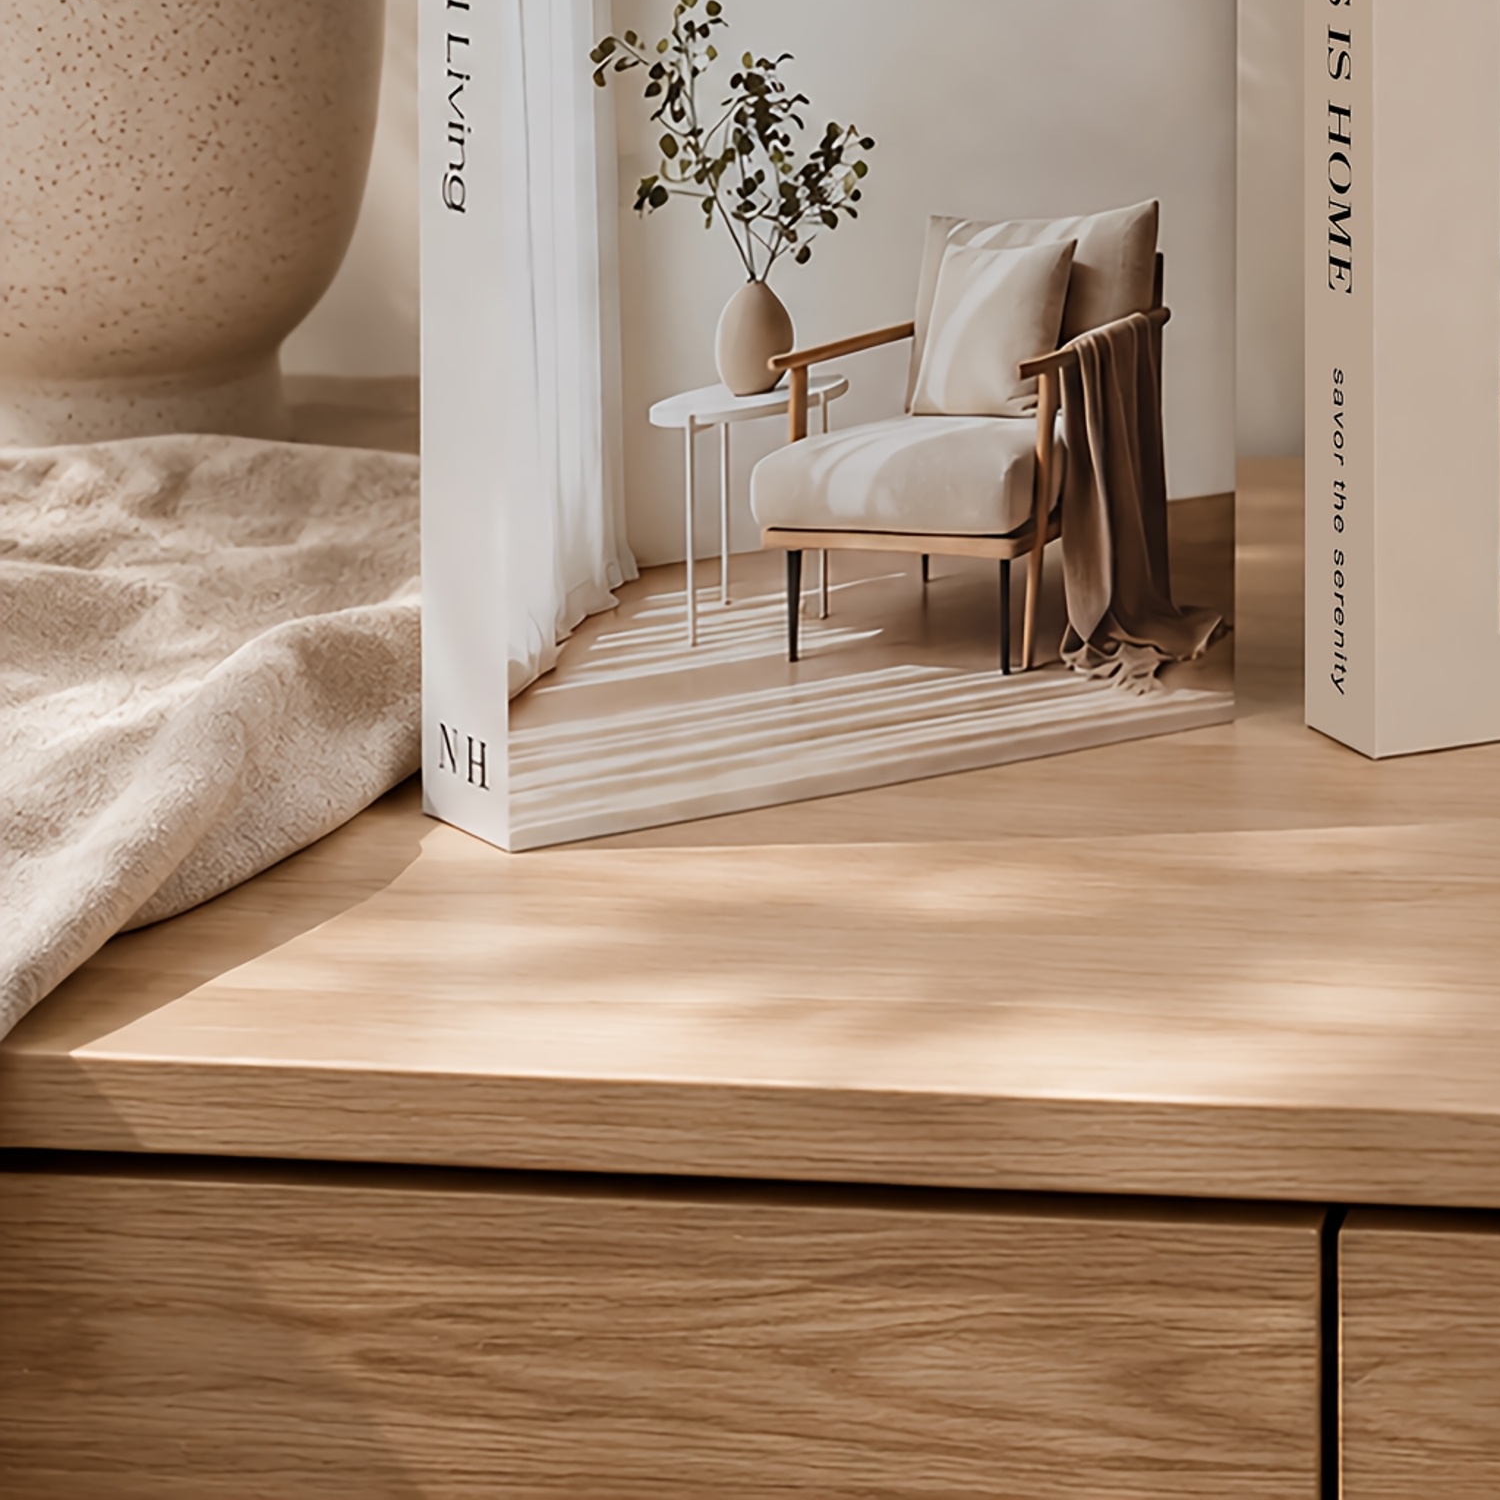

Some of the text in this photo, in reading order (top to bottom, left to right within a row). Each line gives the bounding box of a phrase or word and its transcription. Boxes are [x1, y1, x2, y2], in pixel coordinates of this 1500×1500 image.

[442, 33, 472, 214] Living
[1327, 24, 1352, 81] IS
[1327, 99, 1352, 294] HOME
[1330, 368, 1348, 695] savor the serenity
